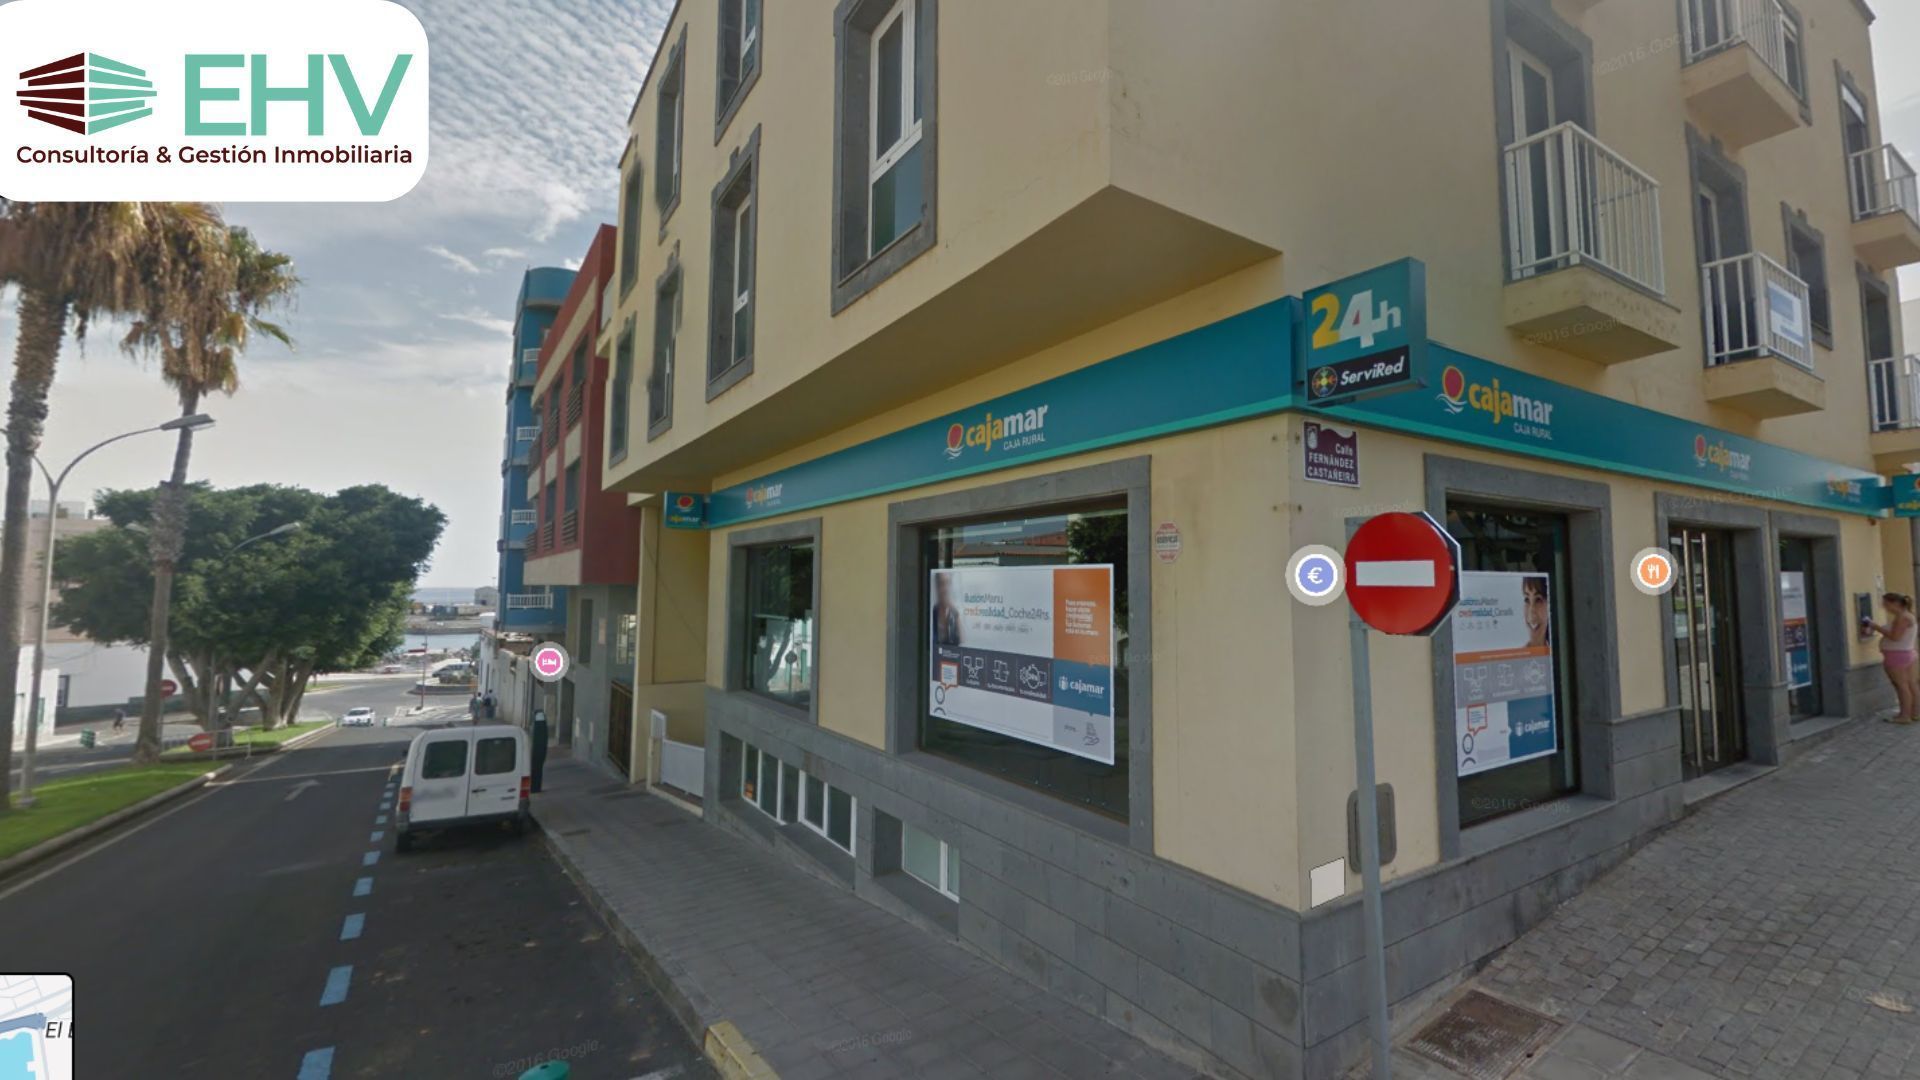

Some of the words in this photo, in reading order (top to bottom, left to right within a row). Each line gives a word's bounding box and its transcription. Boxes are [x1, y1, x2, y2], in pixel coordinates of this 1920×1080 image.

[1311, 289, 1401, 350] 24h
[1340, 355, 1405, 386] ServiRed
[1468, 378, 1553, 425] cajamar
[965, 404, 1049, 453] cajamar
[1513, 422, 1531, 435] CAJA
[1531, 426, 1553, 440] RURAL
[1003, 440, 1021, 451] CAJA
[1022, 432, 1046, 446] RURAL
[1335, 443, 1353, 456] Calle
[1308, 451, 1354, 469] FERNÁNDEZ
[1708, 440, 1751, 472] cajamar
[1307, 466, 1356, 482] CASTAÑEIRA
[752, 483, 783, 507] cajamar
[1070, 680, 1104, 694] cajamar
[1524, 719, 1550, 735] cajamar
